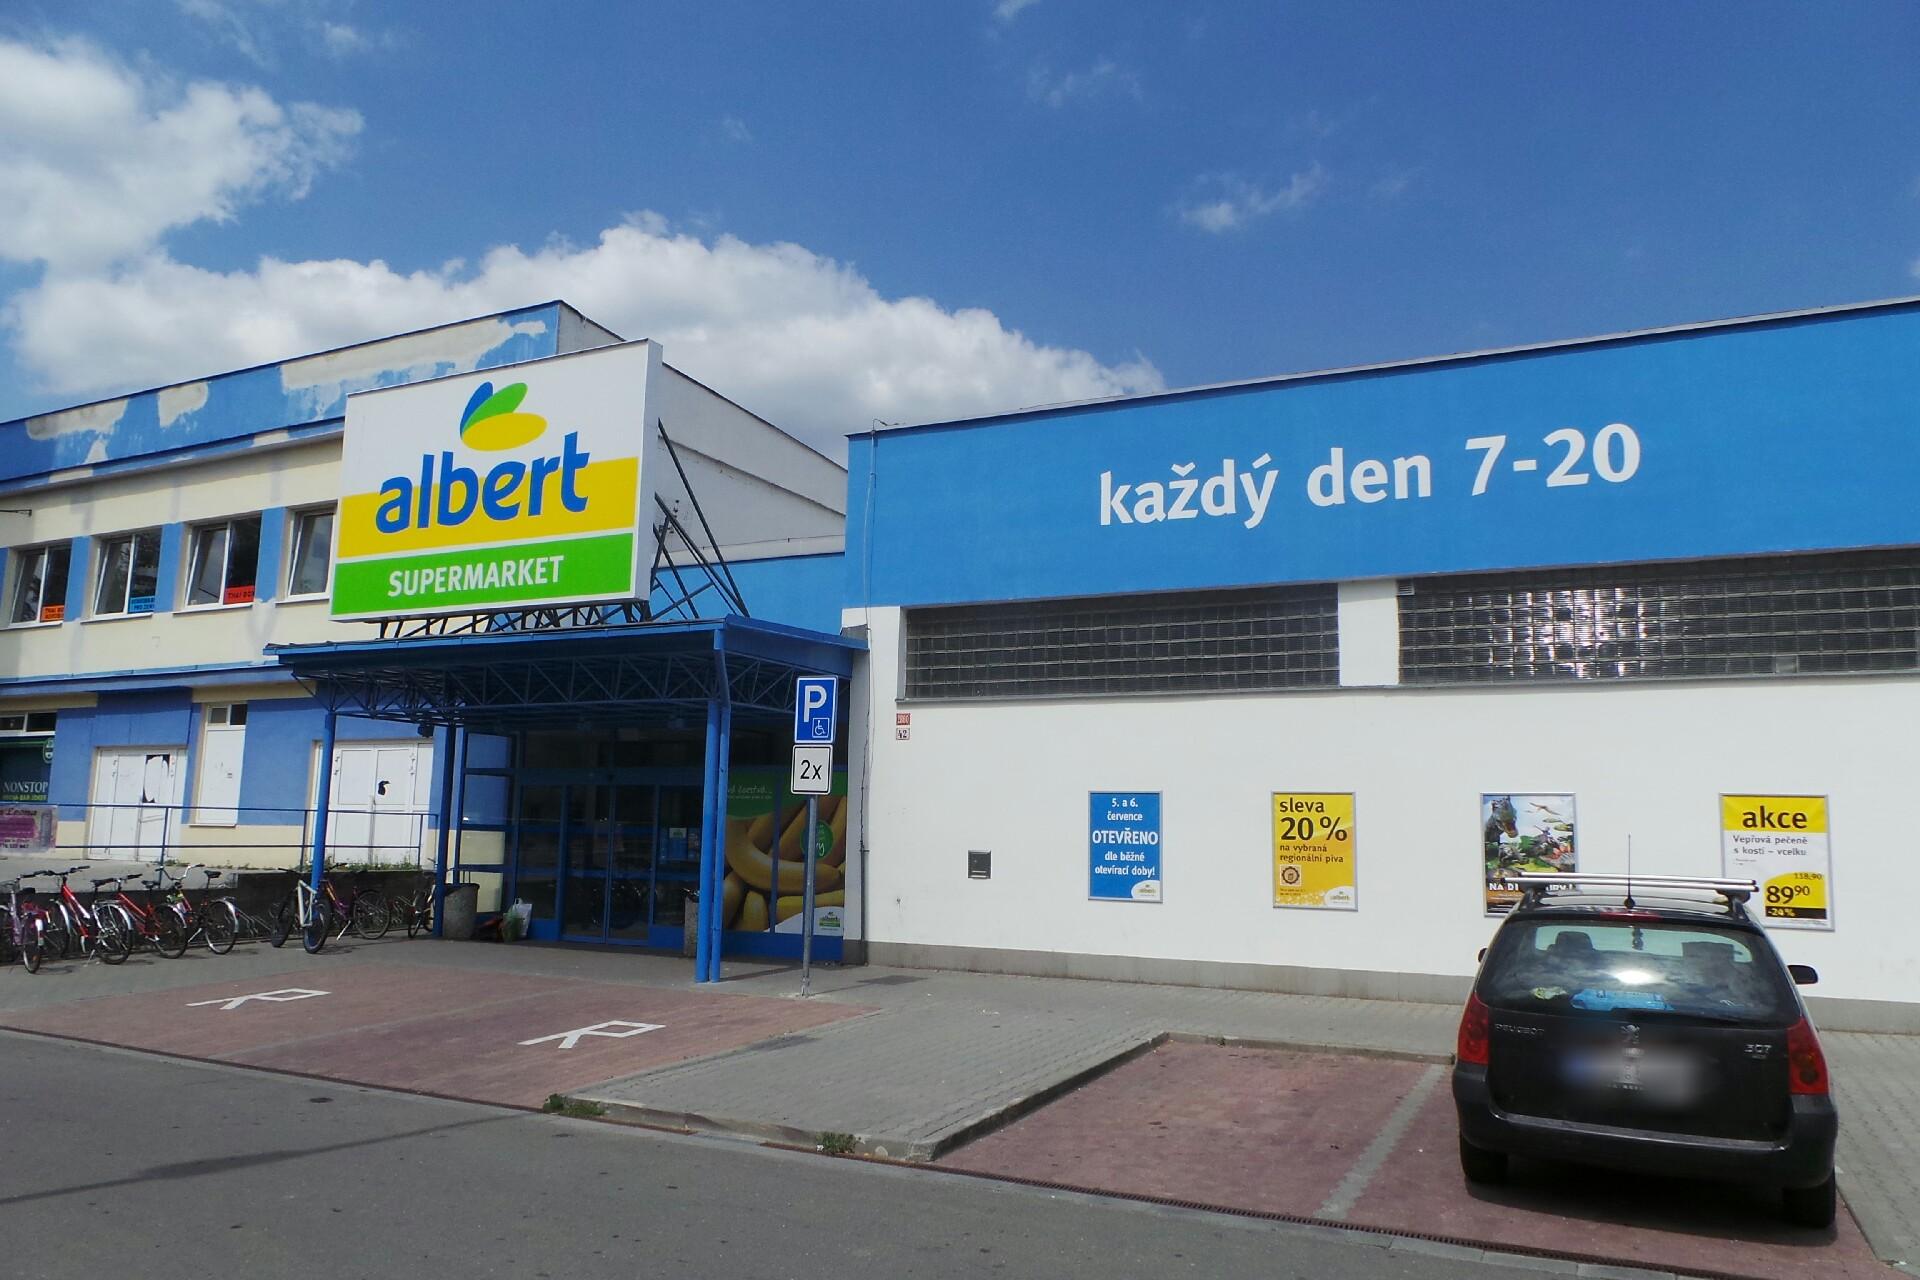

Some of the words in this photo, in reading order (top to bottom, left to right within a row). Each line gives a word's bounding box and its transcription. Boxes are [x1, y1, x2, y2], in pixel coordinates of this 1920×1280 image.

[1100, 453, 1279, 529] každý
[1307, 447, 1432, 507] den
[1464, 423, 1641, 496] 7-20
[375, 431, 590, 534] albert
[387, 555, 564, 598] SUPERMARKET
[803, 685, 827, 723] P
[898, 729, 907, 739] 42
[800, 759, 823, 780] 2x
[3, 781, 49, 793] NONSTOP
[1112, 798, 1120, 807] 5.
[1130, 798, 1138, 807] 6.
[1279, 797, 1325, 813] sleva
[1107, 811, 1143, 821] července
[1742, 805, 1808, 829] akce
[1092, 827, 1159, 845] OTEVŘENO
[1733, 835, 1771, 844] Vepřová
[1774, 836, 1808, 845] pečeně
[1293, 843, 1328, 853] vybraná
[1777, 847, 1807, 856] vcelku
[1105, 851, 1118, 861] dle
[1120, 851, 1145, 862] běžné
[1279, 853, 1322, 863] regionální
[1325, 856, 1344, 864] piva
[1095, 865, 1129, 875] otevírací
[1131, 866, 1155, 878] doby!
[1489, 882, 1504, 891] NA
